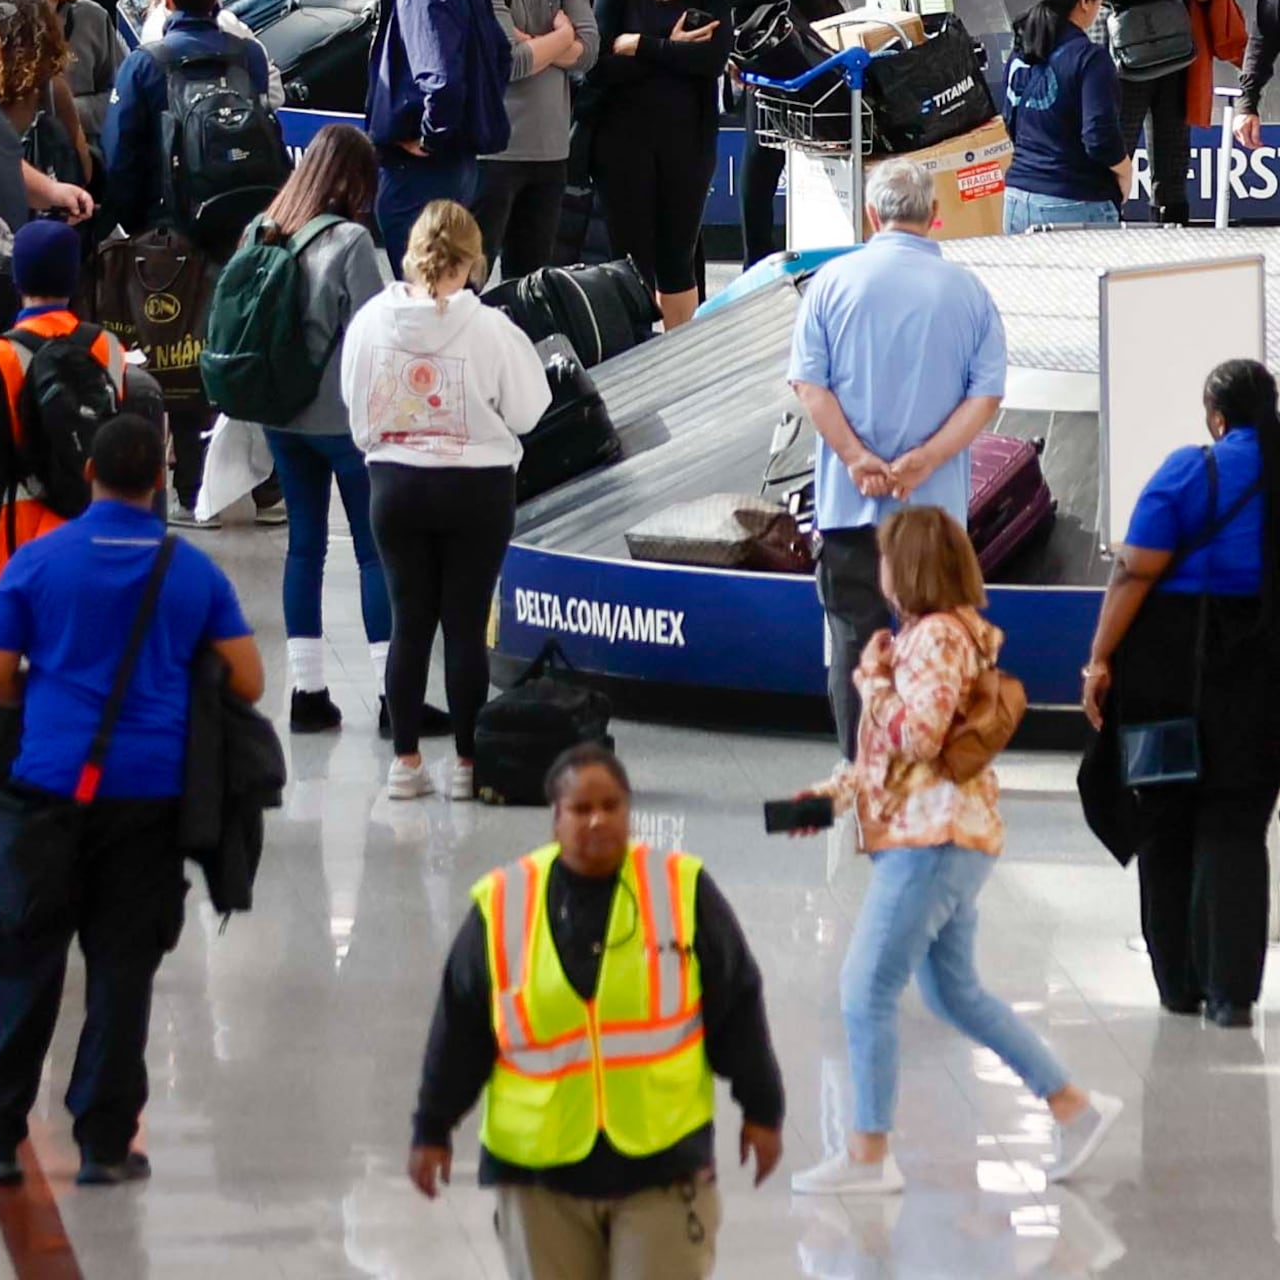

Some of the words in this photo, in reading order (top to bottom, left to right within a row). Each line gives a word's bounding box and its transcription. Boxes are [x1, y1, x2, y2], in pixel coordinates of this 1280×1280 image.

[933, 76, 975, 107] TITANIA
[960, 171, 1001, 189] FRAGILE
[515, 587, 686, 647] DELTA.COM/AMEX
